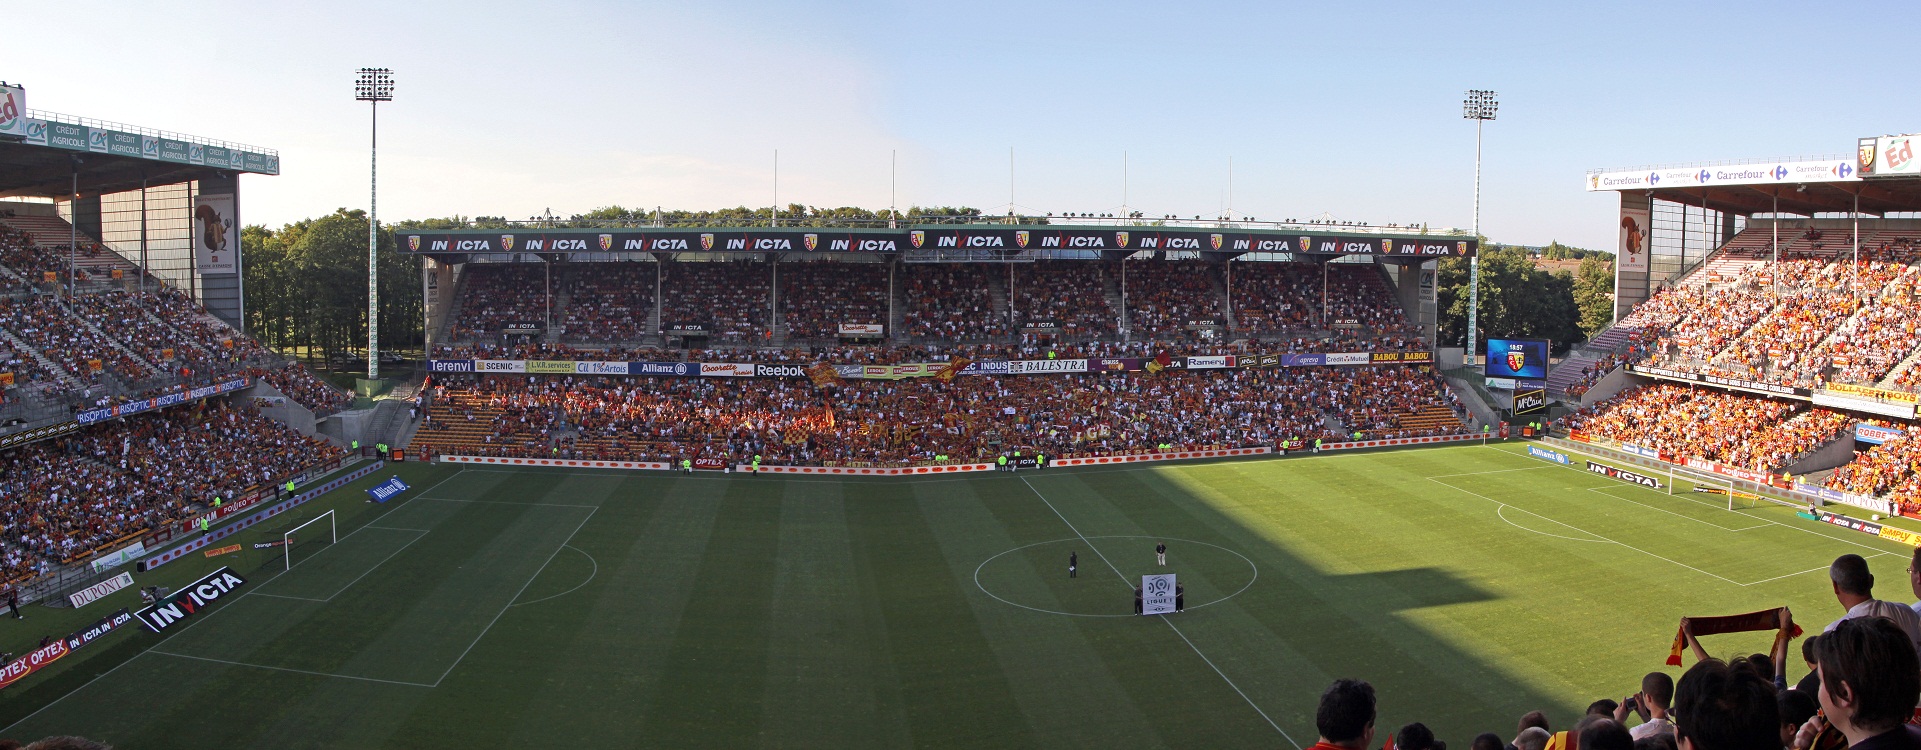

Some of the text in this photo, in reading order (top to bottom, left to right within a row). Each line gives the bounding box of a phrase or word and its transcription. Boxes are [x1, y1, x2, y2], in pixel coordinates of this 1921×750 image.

[52, 136, 85, 148] AGRICOLE
[111, 144, 140, 155] AGRICOLE
[162, 150, 187, 161] AGRICOLE
[206, 157, 228, 166] AGRICOLE
[1716, 170, 1765, 181] Carrefour
[1796, 165, 1829, 174] Carrefour
[1603, 177, 1642, 186] Carrefour
[431, 234, 490, 252] INVICTA
[525, 233, 587, 251] INVICTA
[624, 232, 688, 250] INVICTA
[726, 232, 792, 250] INVICTA
[830, 233, 896, 251] INVICTA
[937, 230, 1004, 249] INVICTA
[1041, 230, 1105, 249] INVICTA
[1140, 231, 1200, 250] INVICTA
[1233, 233, 1289, 252] INVICTA
[1320, 235, 1372, 254] INVICTA
[1400, 239, 1449, 255] INVICTA
[1188, 358, 1225, 367] Ramery
[1374, 353, 1399, 361] BABOU
[1404, 352, 1429, 360] BABOU
[430, 360, 471, 371] Terenvi
[486, 362, 513, 370] SCENIC
[578, 362, 589, 372] Cil
[642, 363, 674, 373] Allianz
[757, 364, 805, 377] Reebok
[980, 362, 1008, 370] INDUS
[1026, 360, 1086, 372] BALESTRA
[1769, 384, 1794, 394] COULEURS
[1829, 383, 1916, 403] BOLLAERT BOYS
[1516, 396, 1544, 412] McCain
[1858, 428, 1888, 440] ROBBE
[1531, 447, 1556, 460] Allianz
[696, 458, 723, 466] OPTEX
[1687, 458, 1714, 472] LOXAM
[1589, 464, 1654, 487] INVICTA
[372, 483, 398, 500] Allianz
[1845, 495, 1886, 512] DUPONT
[1822, 514, 1850, 527] INVICTA
[1851, 522, 1880, 535] INVICTA
[74, 577, 122, 607] DUPONT
[150, 572, 243, 628] INVICTA
[102, 613, 131, 633] INVICTA
[70, 627, 102, 650] INVICTA
[31, 640, 65, 665] OPTEX
